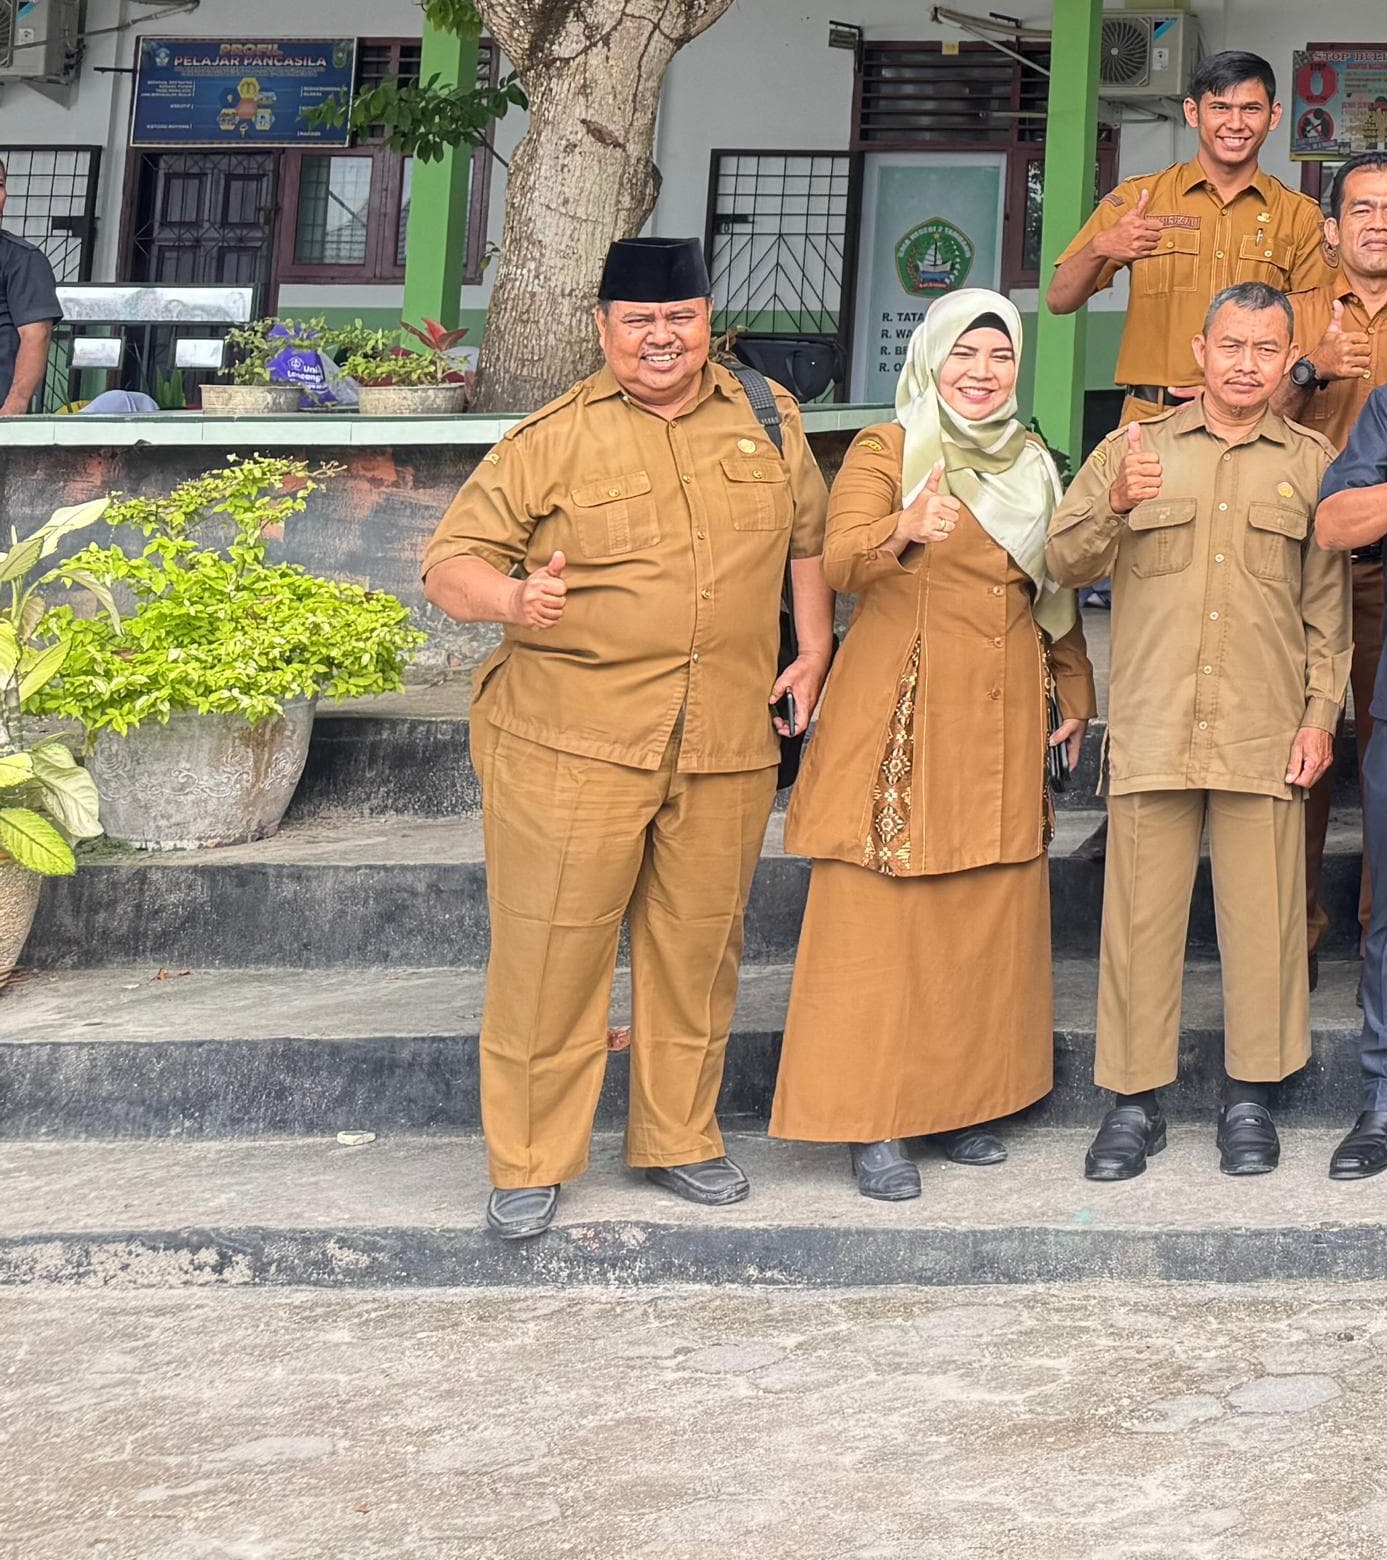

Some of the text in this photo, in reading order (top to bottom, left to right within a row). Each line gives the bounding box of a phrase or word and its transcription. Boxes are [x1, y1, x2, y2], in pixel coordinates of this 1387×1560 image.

[220, 43, 283, 54] PROFIL
[174, 55, 328, 67] PELAJAR PANCASILA
[1312, 52, 1349, 61] STOP
[882, 312, 893, 322] R.
[881, 329, 913, 339] R. WA
[880, 345, 891, 356] R.
[879, 362, 890, 372] R.
